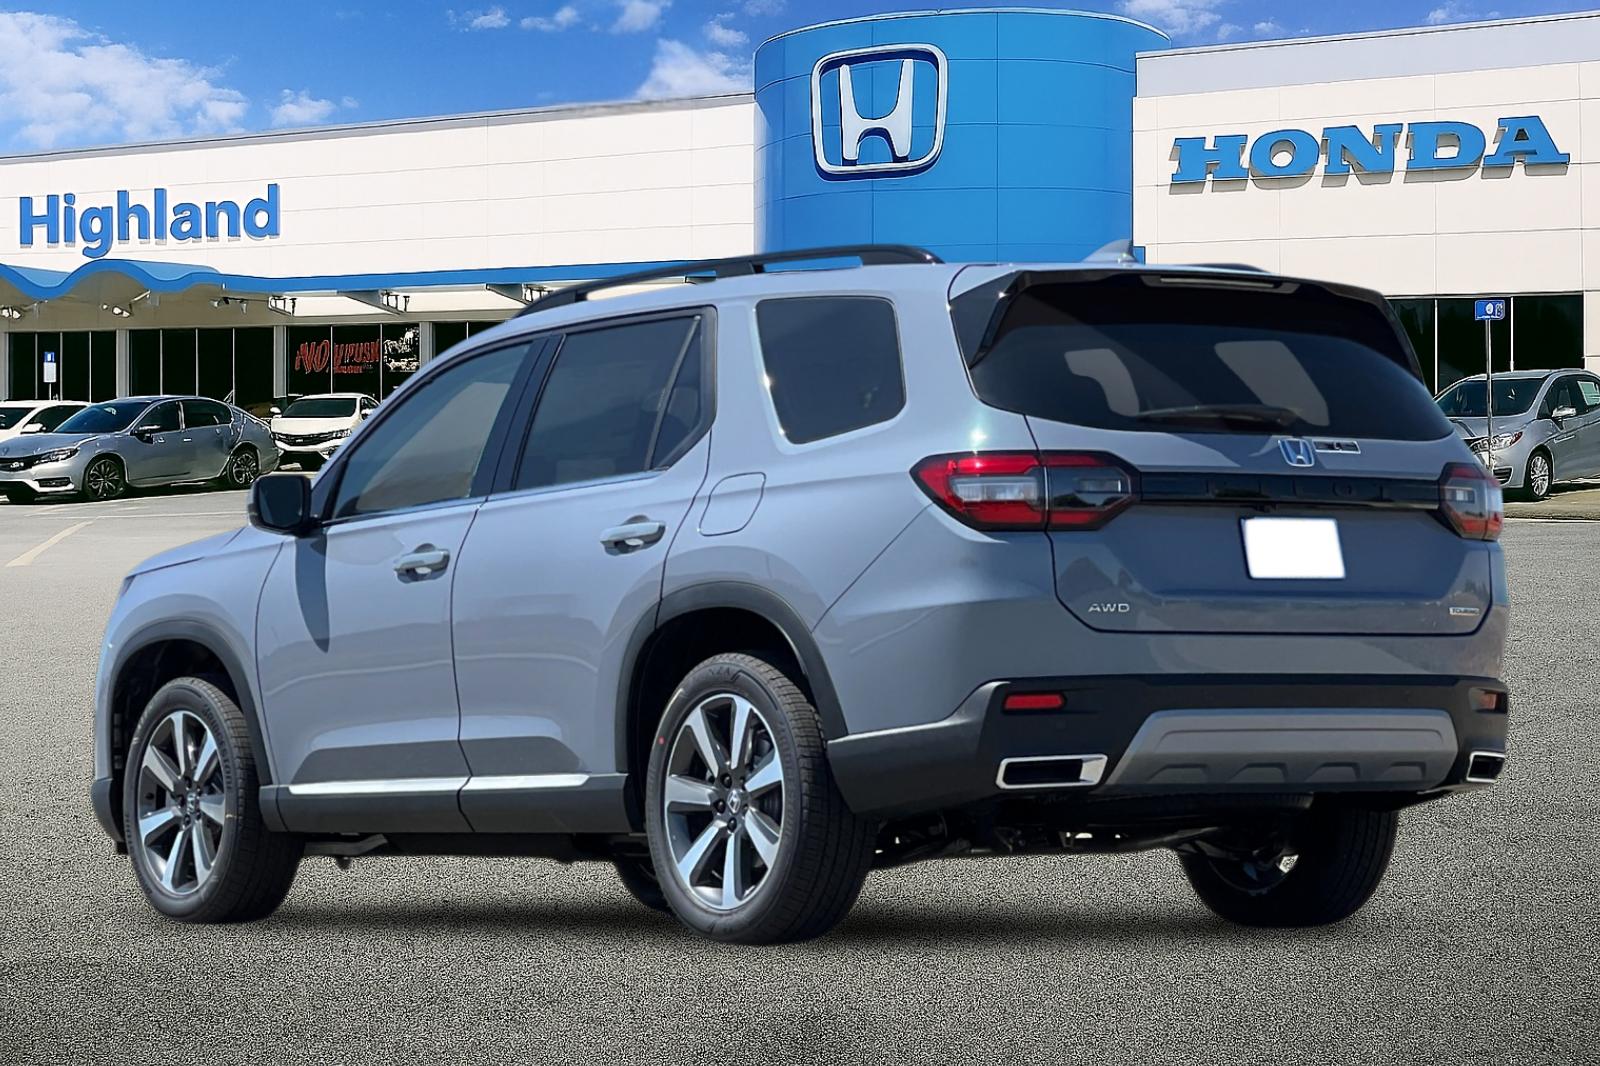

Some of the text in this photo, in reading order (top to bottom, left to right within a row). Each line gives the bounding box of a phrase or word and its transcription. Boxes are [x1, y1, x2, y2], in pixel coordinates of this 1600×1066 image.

[1171, 115, 1571, 185] HONDA
[19, 183, 281, 258] Highland
[1088, 603, 1130, 613] AWD
